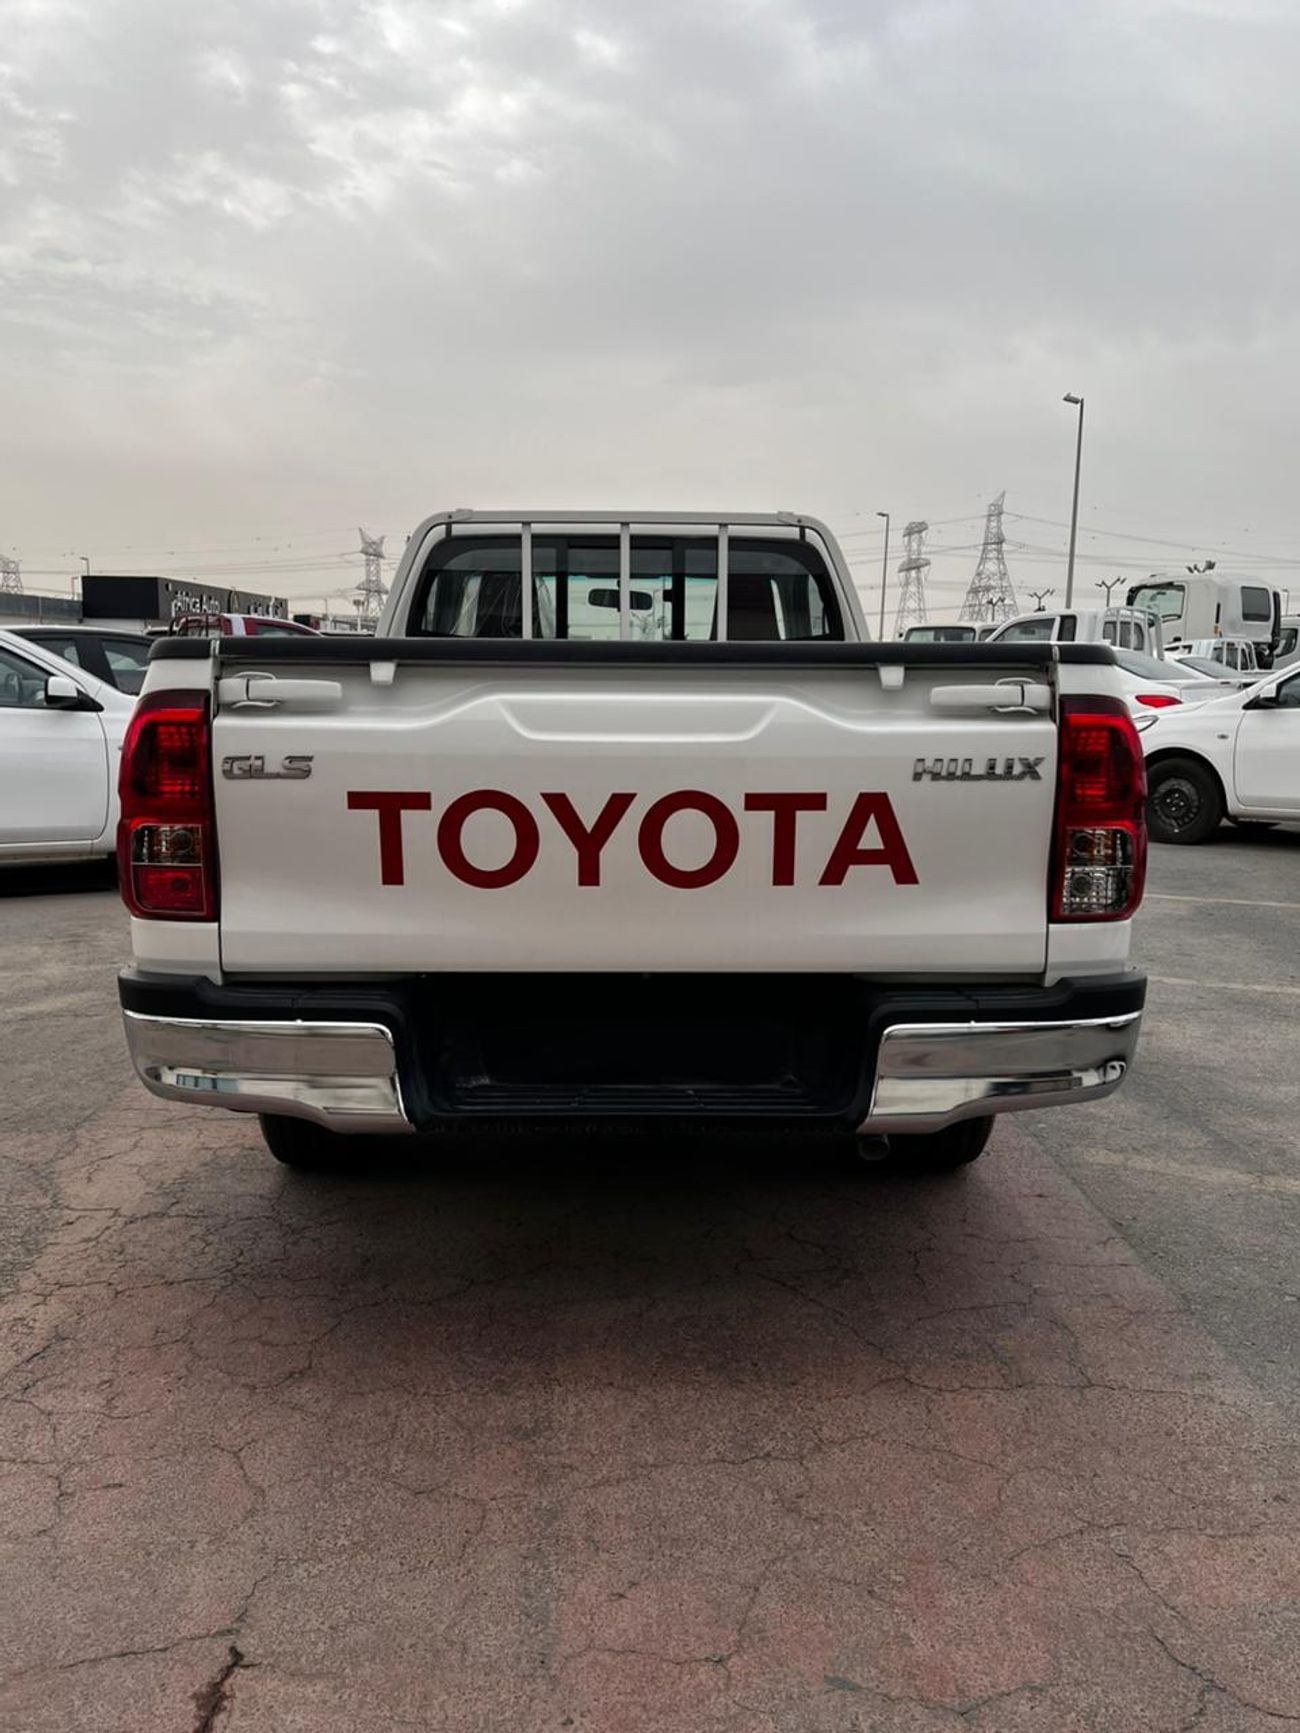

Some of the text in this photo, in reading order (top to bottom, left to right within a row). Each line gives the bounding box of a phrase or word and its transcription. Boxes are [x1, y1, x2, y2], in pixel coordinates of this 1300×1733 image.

[221, 755, 314, 780] GLS
[912, 756, 1047, 782] HILUX
[347, 789, 919, 889] TOYOTA
